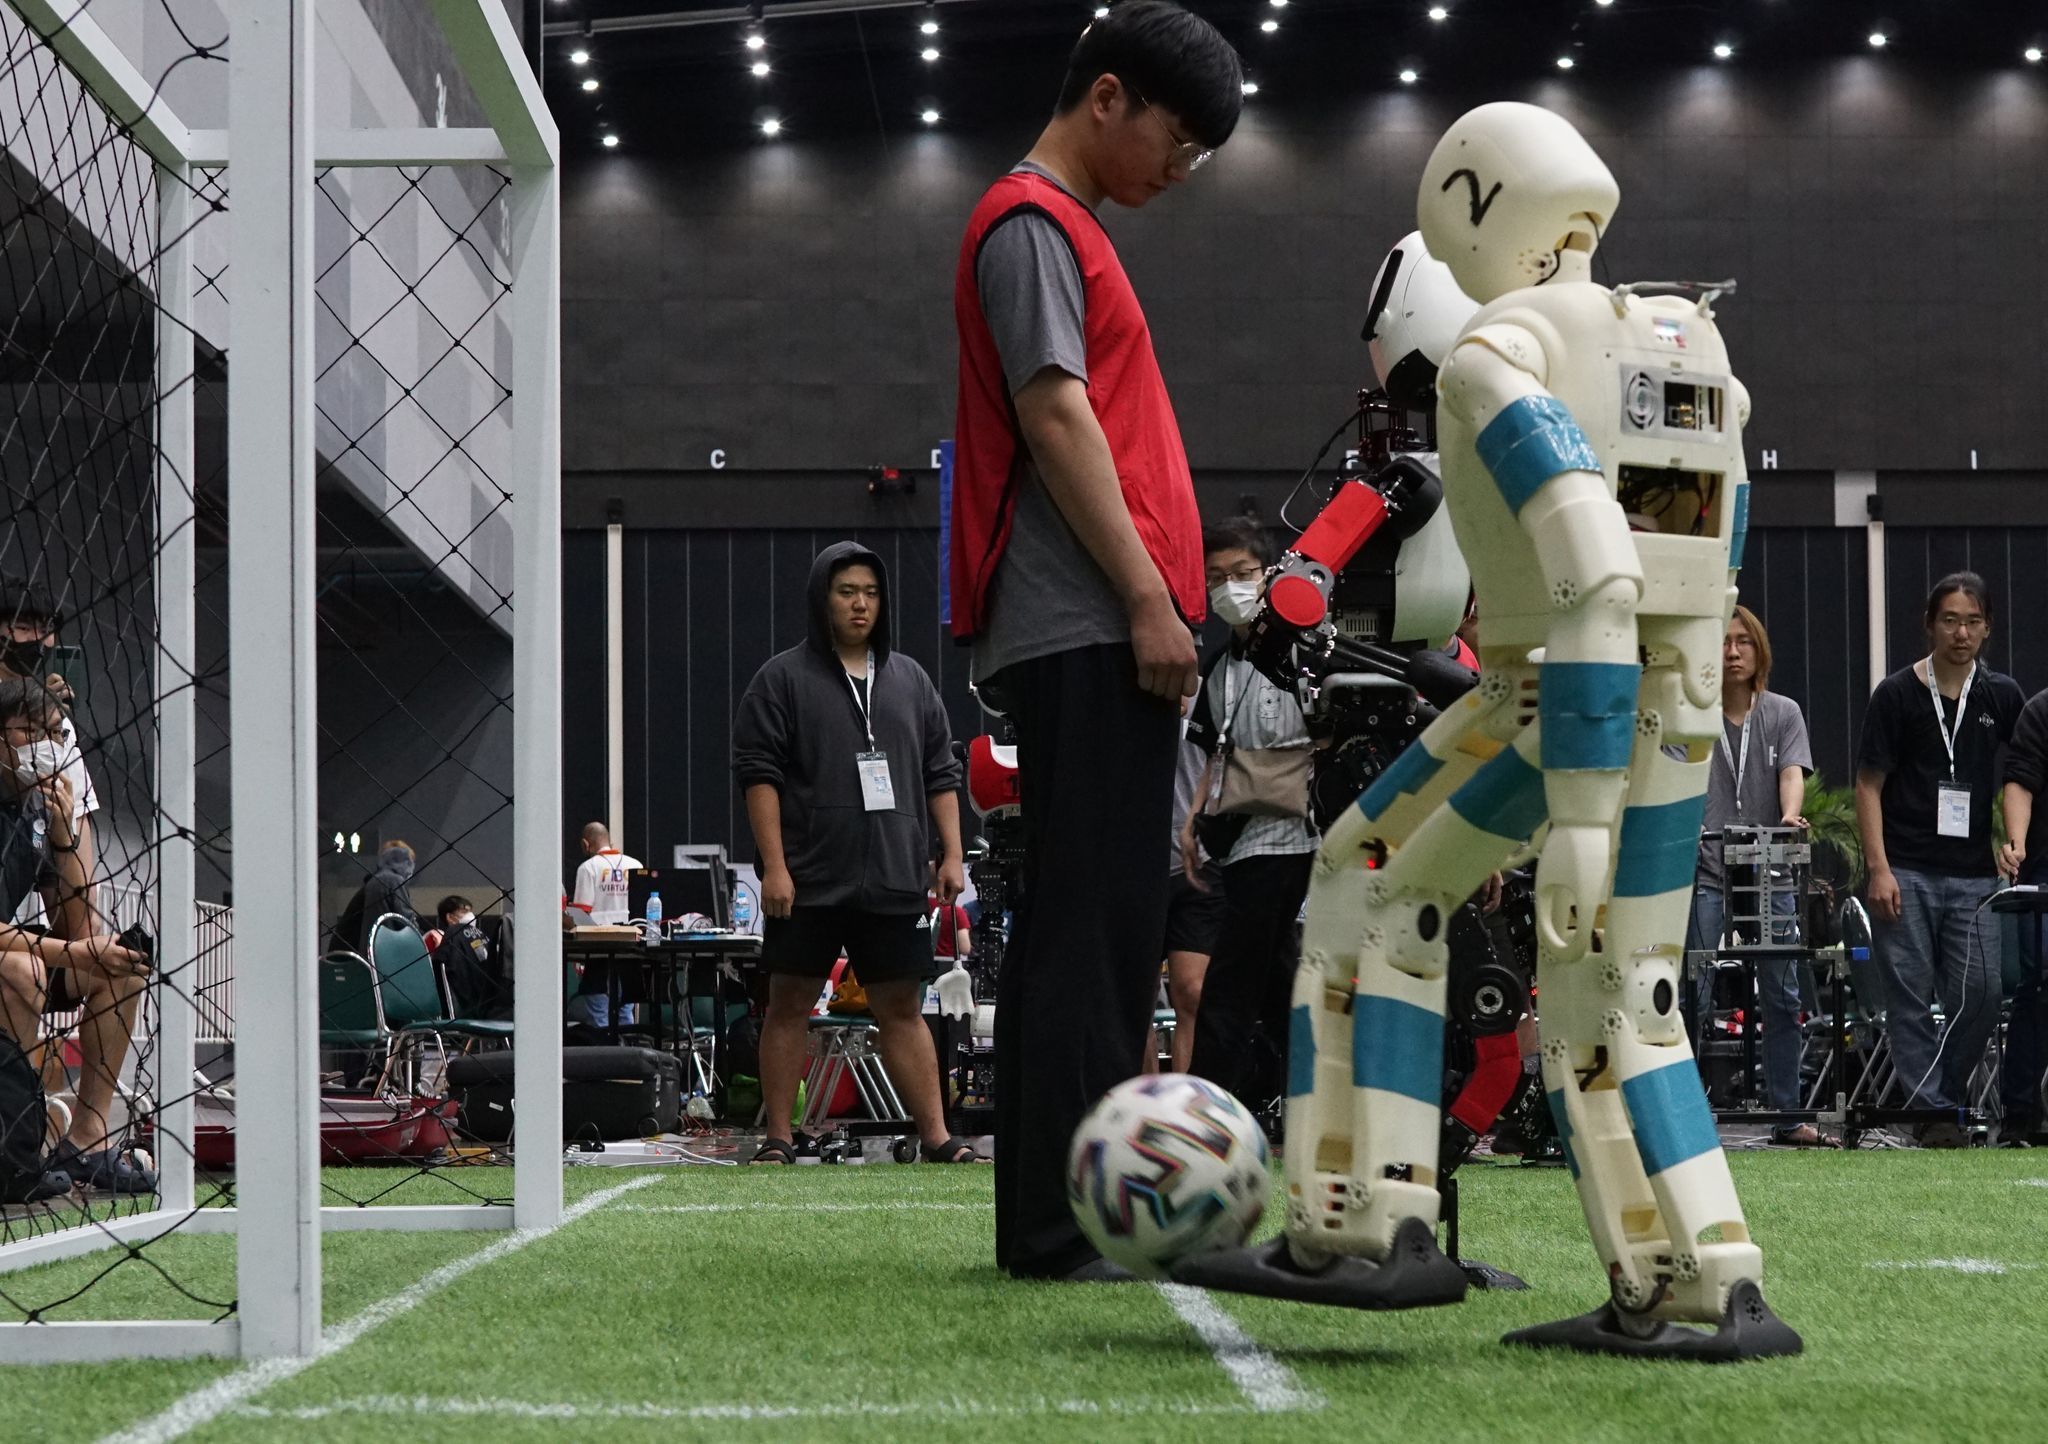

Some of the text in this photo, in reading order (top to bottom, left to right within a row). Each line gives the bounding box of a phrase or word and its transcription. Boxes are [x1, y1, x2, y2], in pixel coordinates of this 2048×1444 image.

[1441, 168, 1503, 227] 2
[710, 449, 725, 469] C
[1761, 449, 1778, 470] H
[1970, 449, 1977, 470] I
